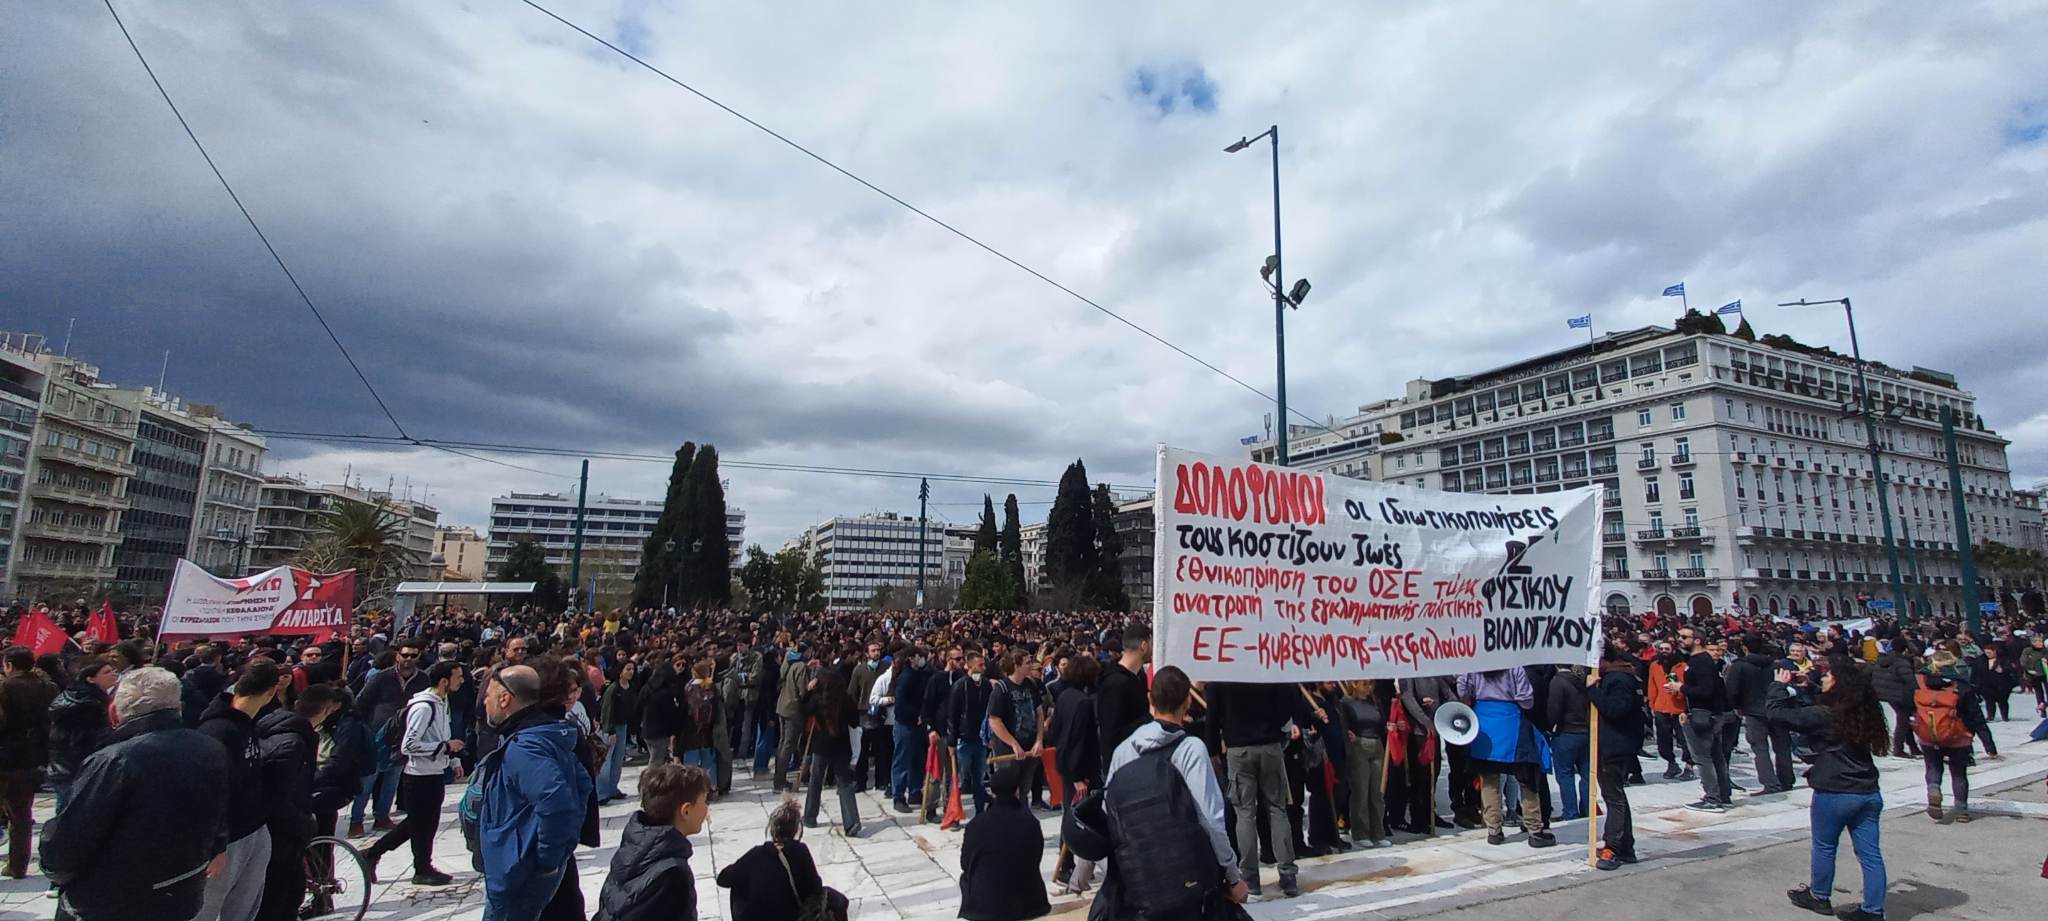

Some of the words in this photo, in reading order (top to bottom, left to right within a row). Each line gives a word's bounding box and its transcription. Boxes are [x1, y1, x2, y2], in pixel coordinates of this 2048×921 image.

[1174, 461, 1326, 526] ΔΟΛΟΦΟΝΟΙ
[1345, 499, 1371, 521] οι
[1176, 524, 1225, 556] τους
[1227, 523, 1347, 566] κοστίζουν
[1352, 533, 1404, 570] ζωές
[1312, 575, 1357, 595] του
[1369, 568, 1423, 600] ΟΣΕ
[1481, 573, 1574, 613] ΦΥΣΙΚΟΥ
[1174, 588, 1263, 622] ανατροπή
[1274, 599, 1306, 624] της
